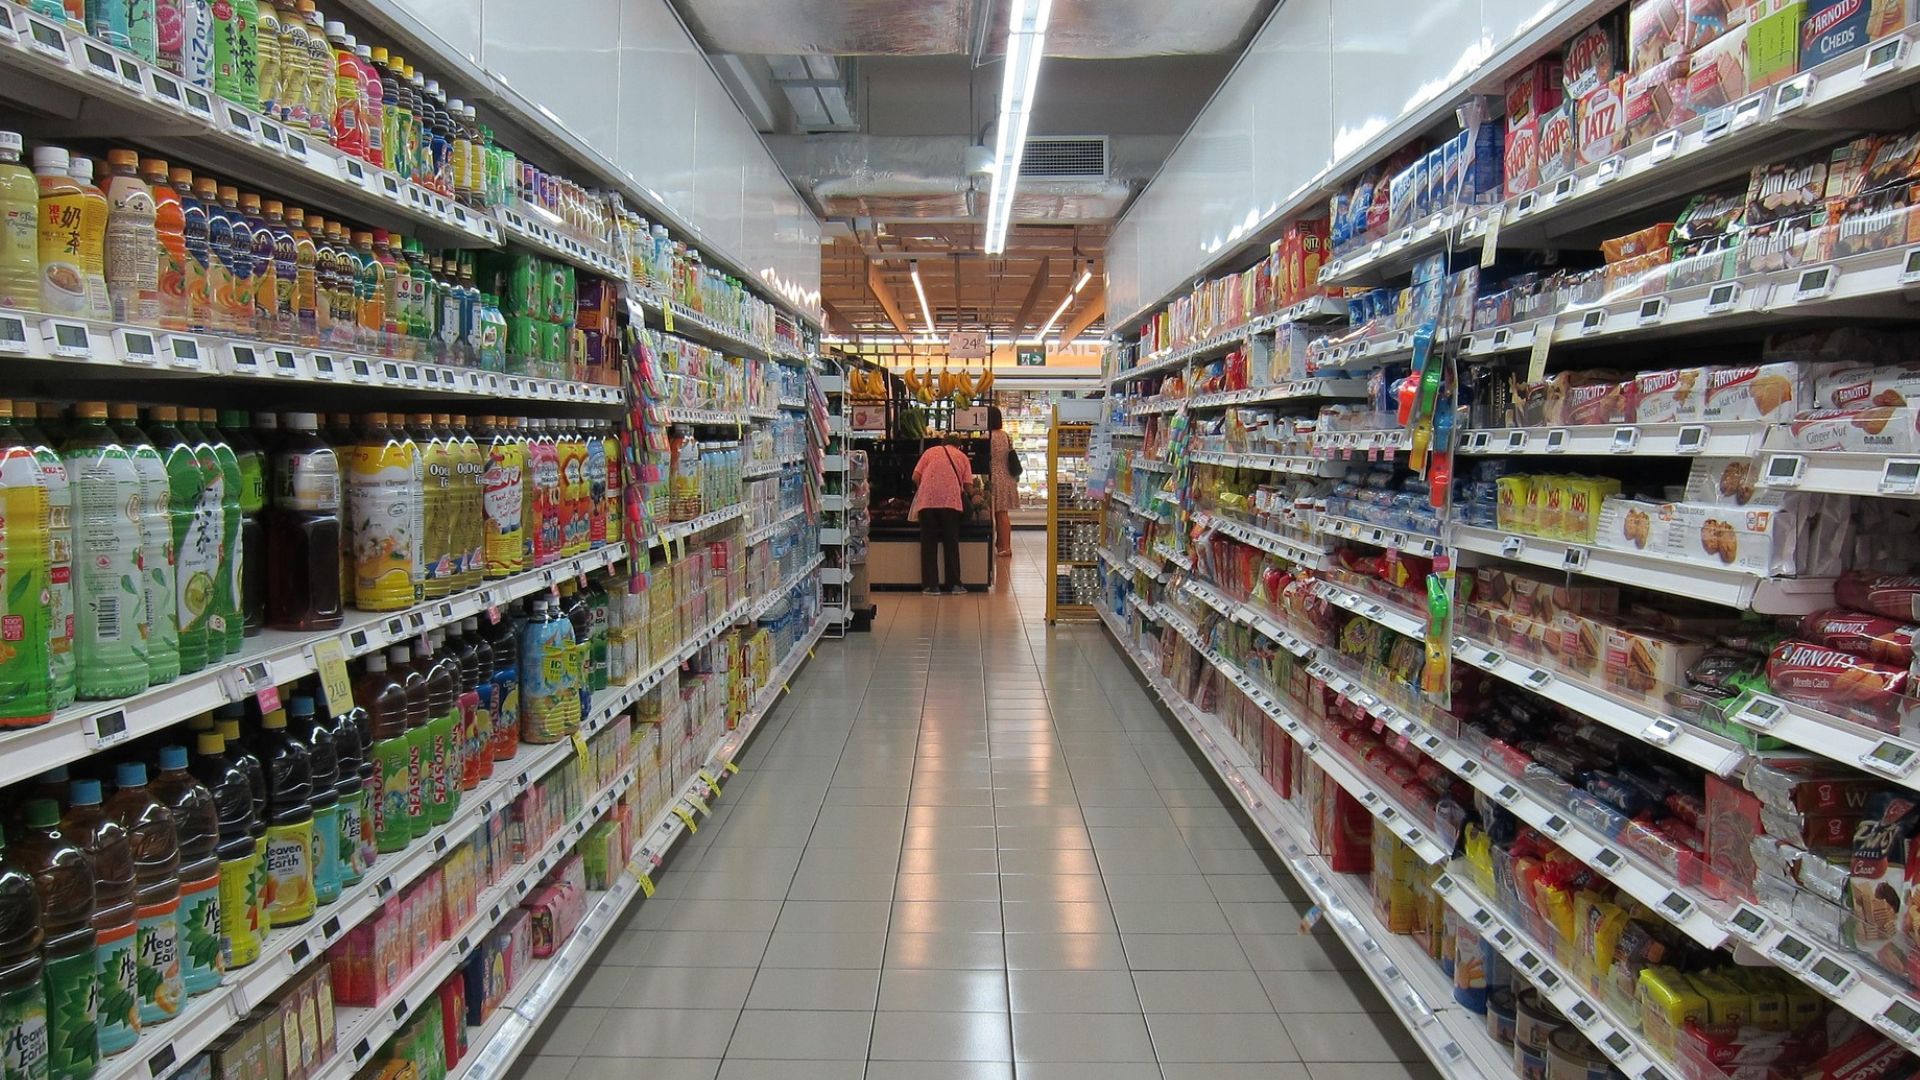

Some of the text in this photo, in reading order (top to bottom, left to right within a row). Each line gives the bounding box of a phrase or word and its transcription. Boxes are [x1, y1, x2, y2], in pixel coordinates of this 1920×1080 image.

[1820, 26, 1855, 54] CHEDS
[1304, 238, 1320, 249] RITZ
[1806, 425, 1847, 445] Ginger Nut
[1793, 676, 1830, 689] Monte Carlo
[433, 734, 445, 805] SEASONS
[408, 744, 422, 818] SEASONS
[372, 758, 385, 833] SEASONS
[343, 813, 360, 831] Hea
[267, 854, 299, 871] Earth
[141, 932, 178, 957] Hea
[152, 951, 174, 967] Ear
